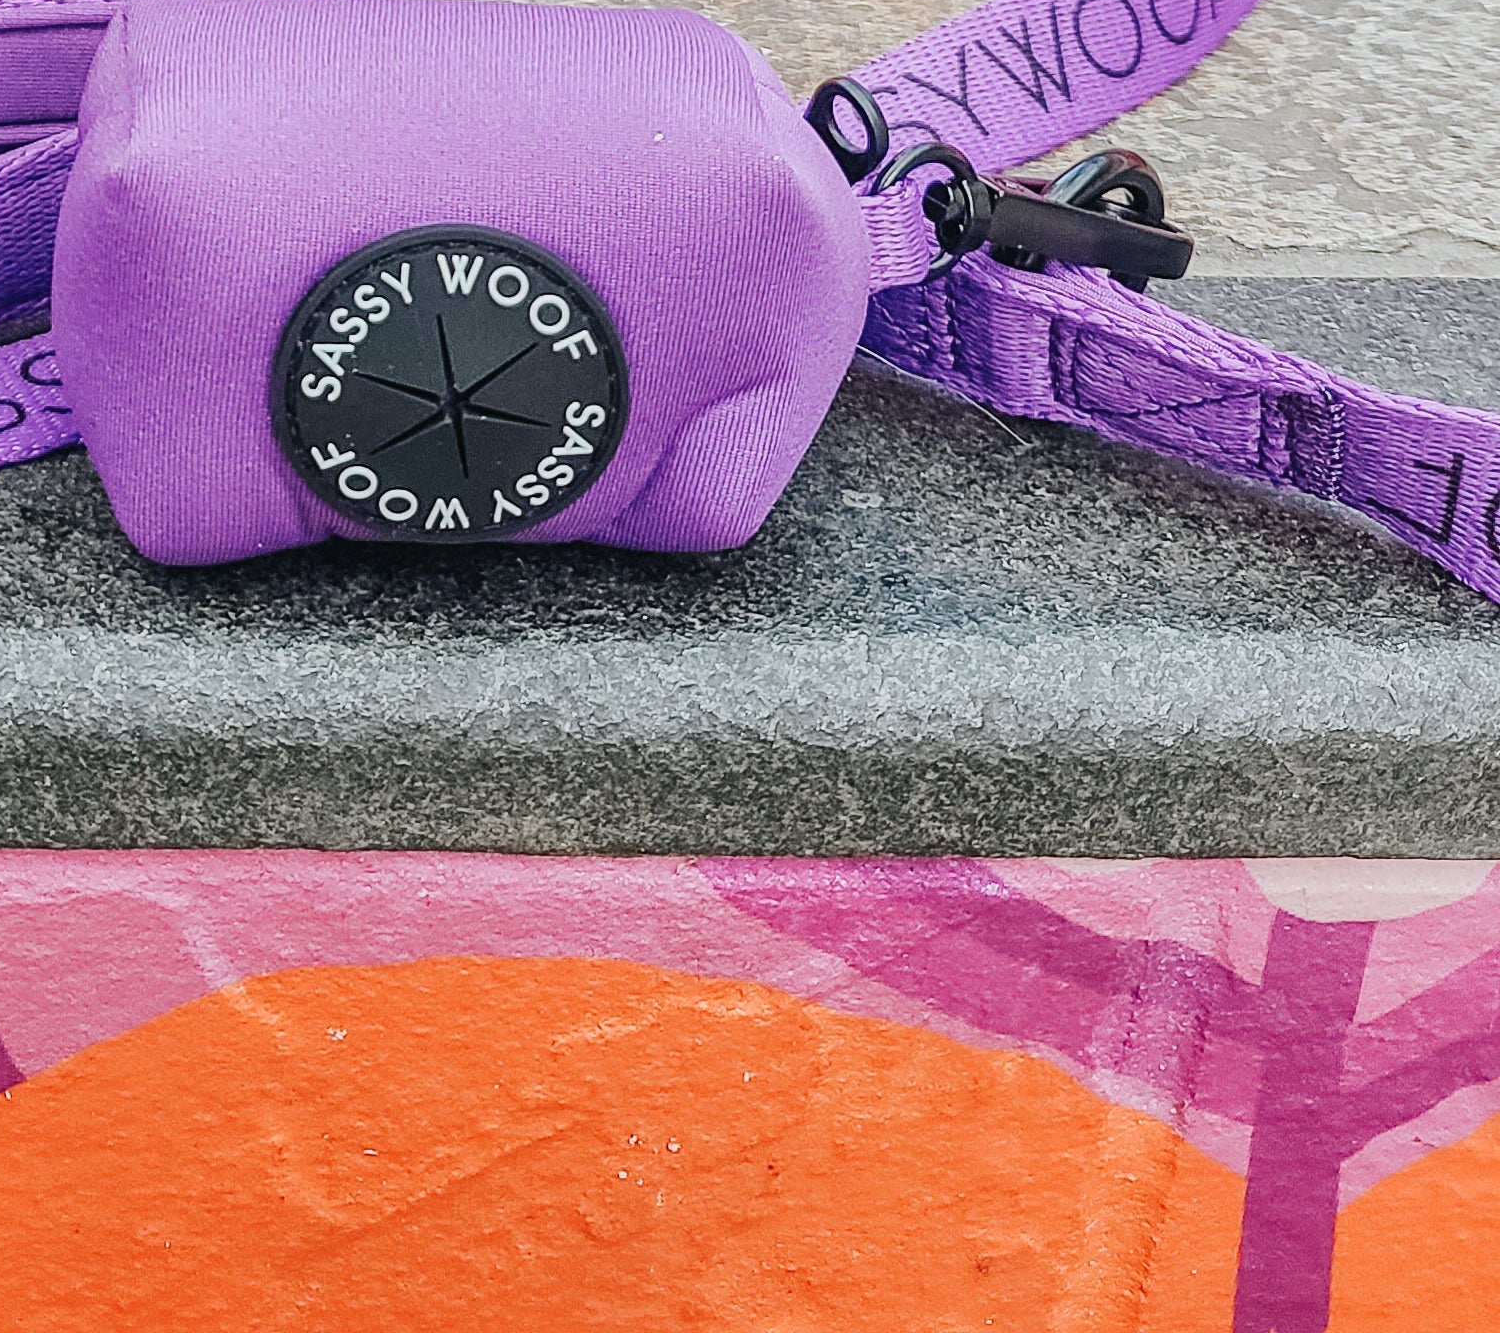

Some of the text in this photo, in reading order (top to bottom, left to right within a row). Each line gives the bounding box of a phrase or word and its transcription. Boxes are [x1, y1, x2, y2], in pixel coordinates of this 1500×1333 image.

[300, 253, 599, 403] SASSY WOOF
[310, 400, 607, 530] SASSY WOOF
